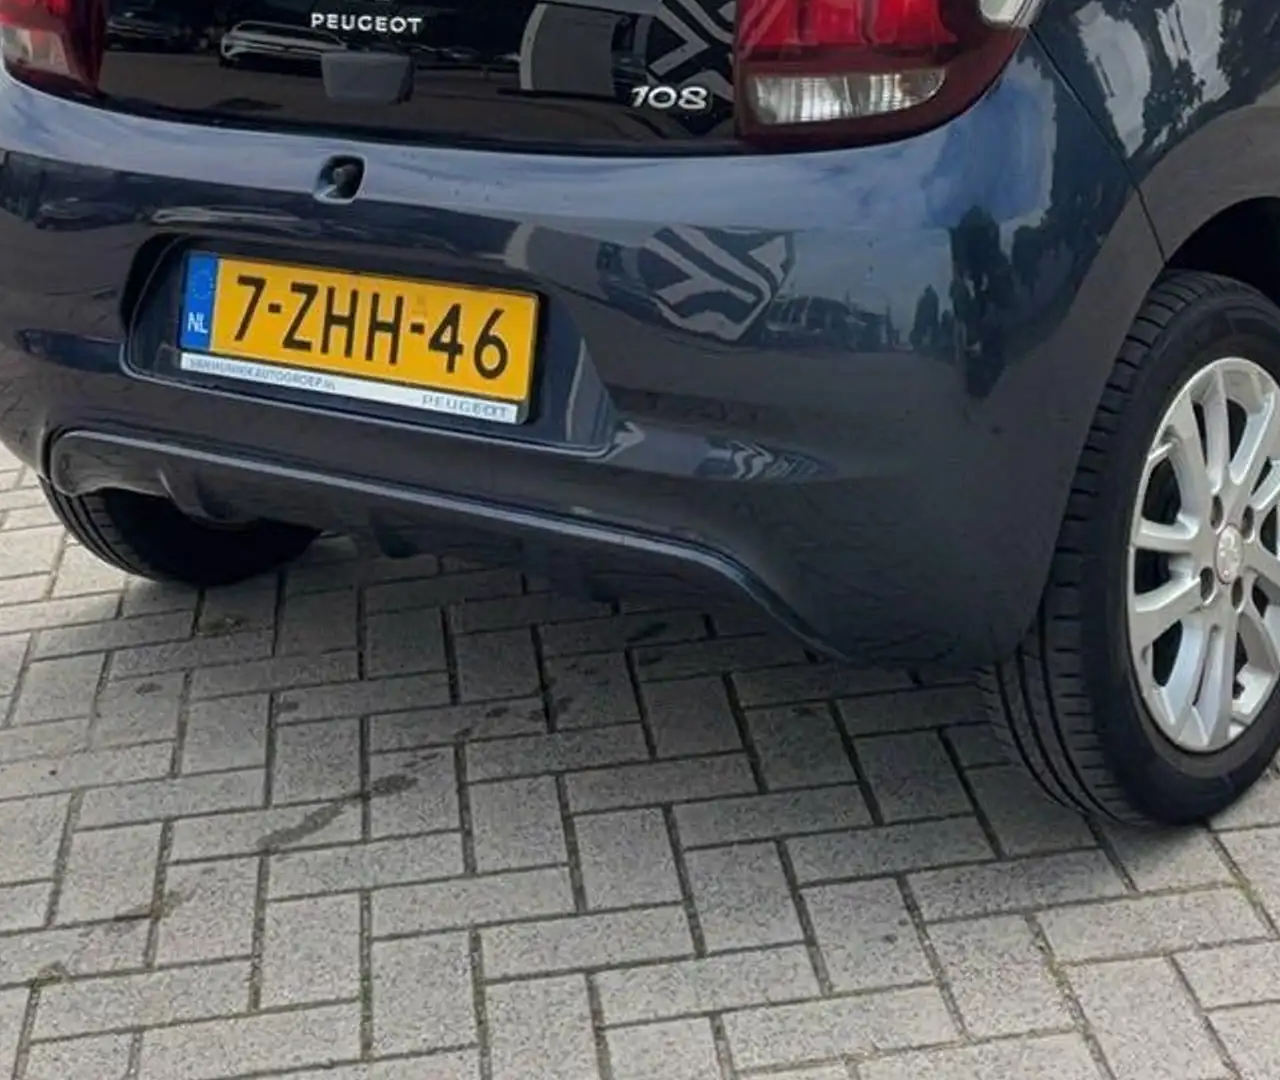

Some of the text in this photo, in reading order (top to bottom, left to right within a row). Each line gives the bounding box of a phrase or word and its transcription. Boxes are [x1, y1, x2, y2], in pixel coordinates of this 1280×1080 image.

[310, 12, 423, 34] PEUGEOT
[631, 85, 708, 110] 108
[187, 311, 209, 334] NL
[233, 274, 510, 381] 7-ZHH-46
[422, 394, 509, 419] PEUGEOT
